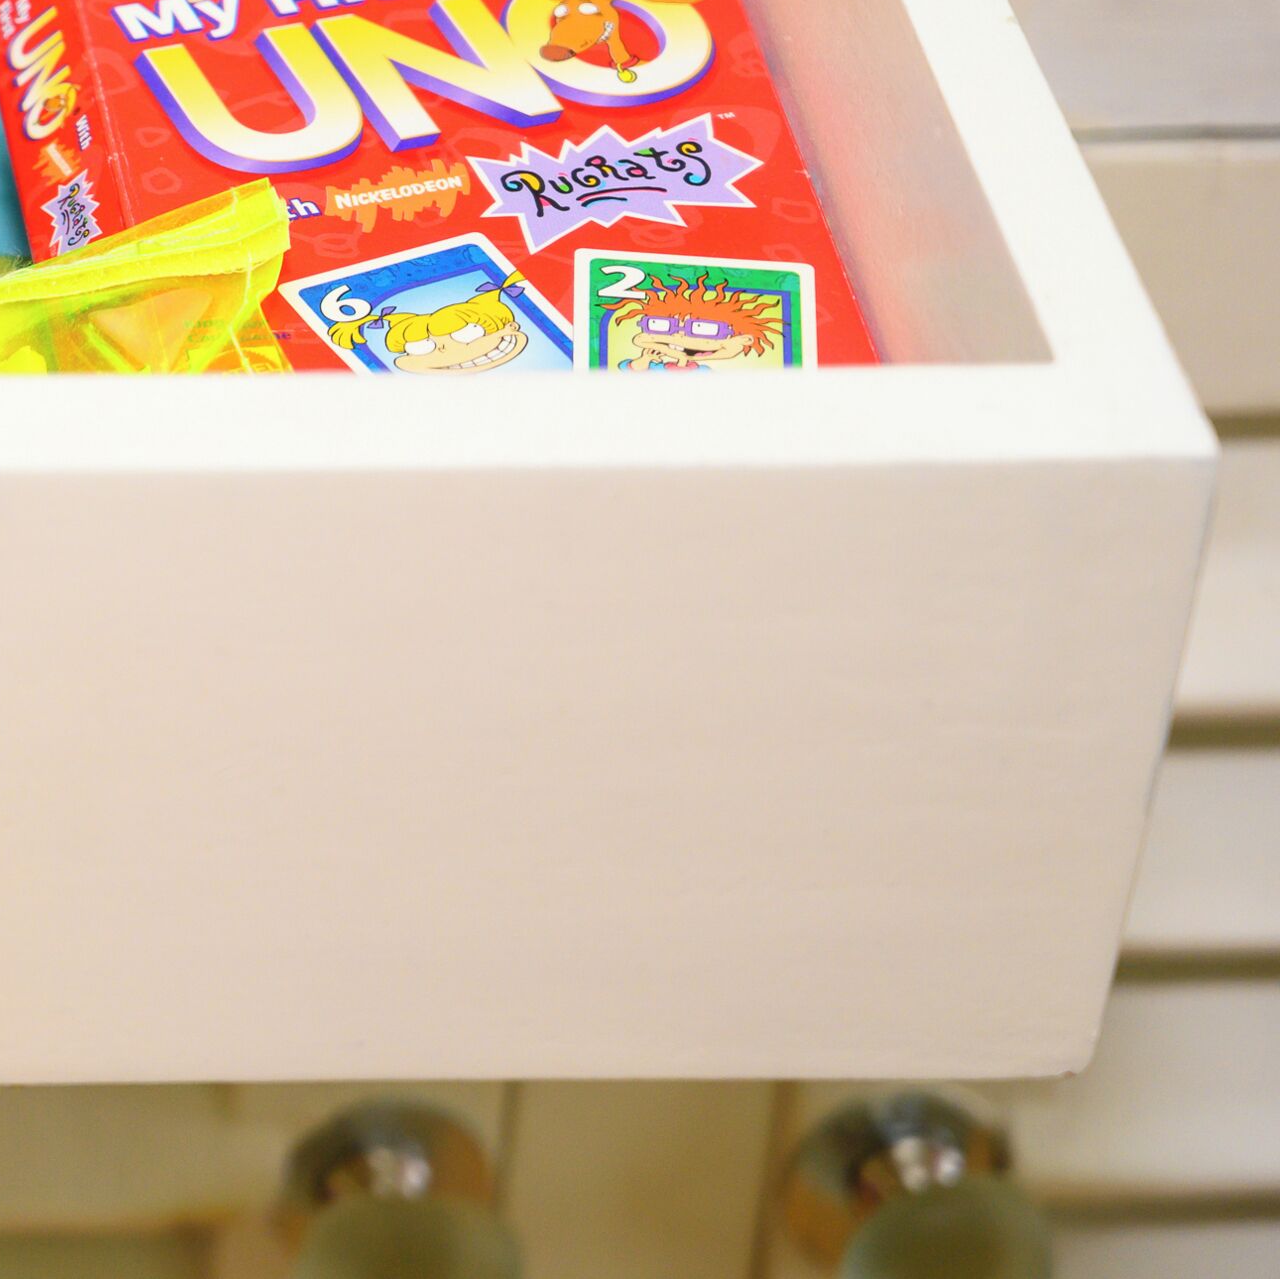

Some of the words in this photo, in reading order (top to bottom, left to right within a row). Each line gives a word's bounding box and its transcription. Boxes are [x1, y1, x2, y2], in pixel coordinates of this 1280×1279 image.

[6, 5, 79, 142] UNO
[597, 265, 648, 300] 2
[320, 284, 372, 323] 6
